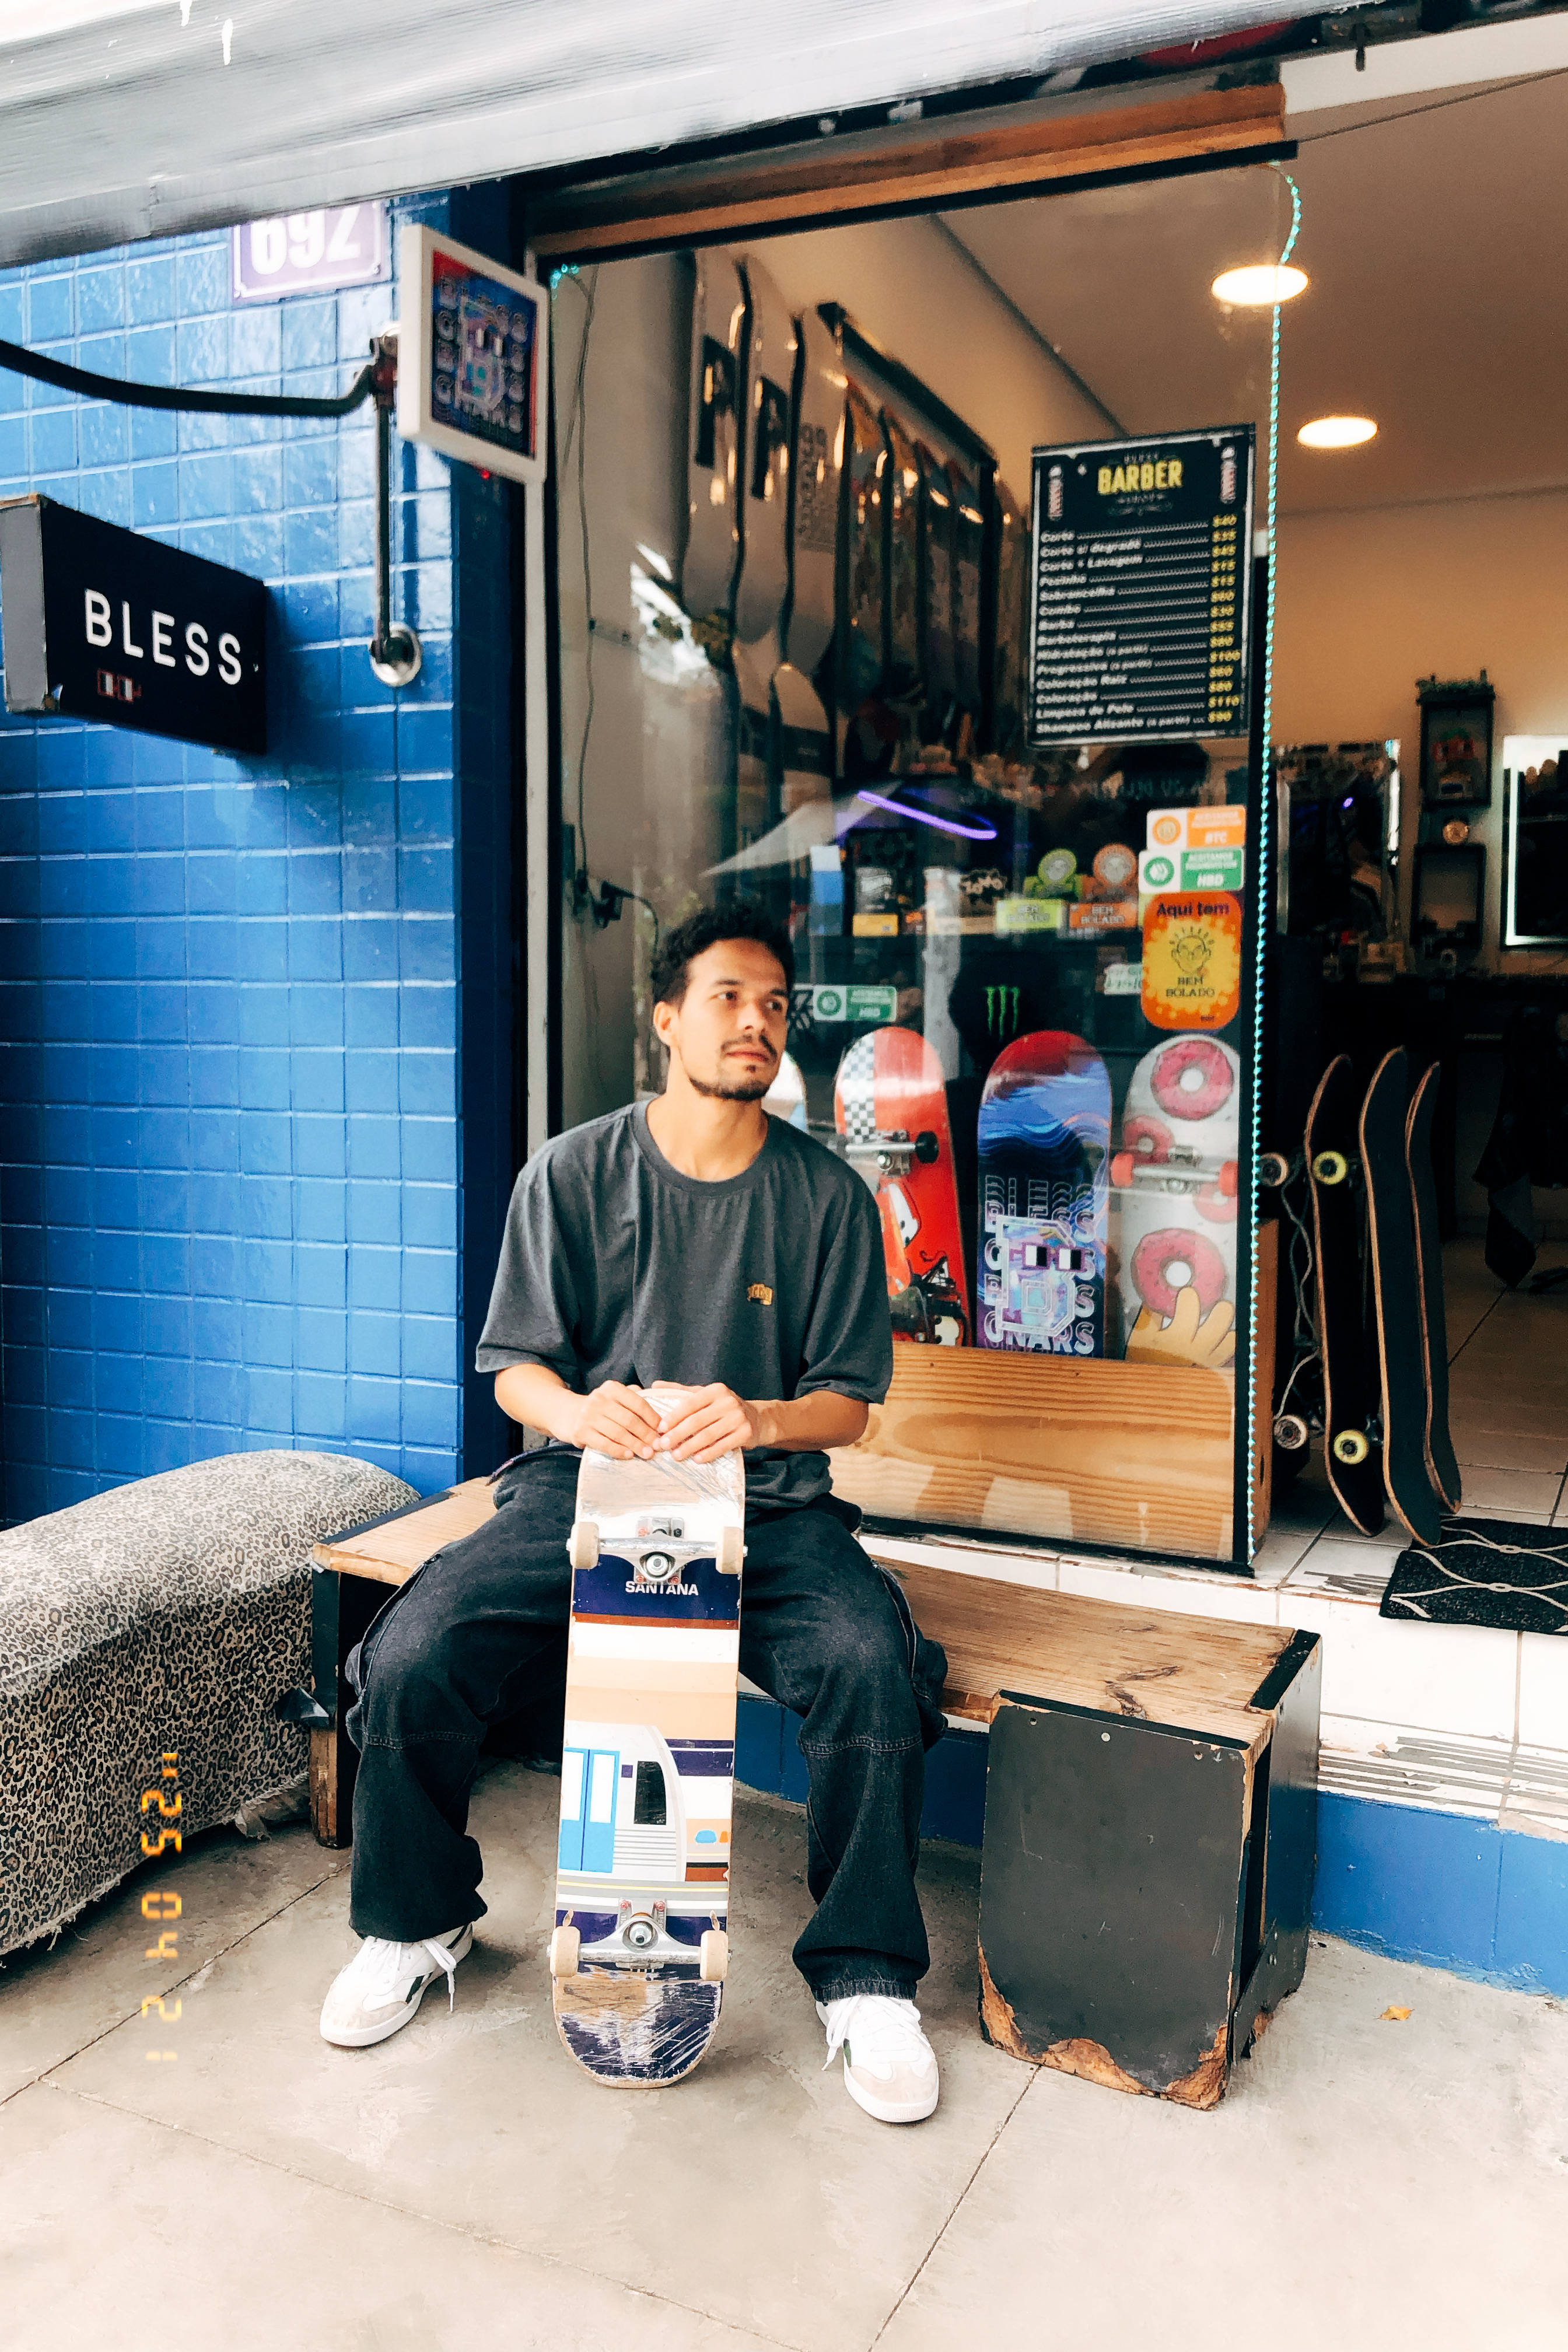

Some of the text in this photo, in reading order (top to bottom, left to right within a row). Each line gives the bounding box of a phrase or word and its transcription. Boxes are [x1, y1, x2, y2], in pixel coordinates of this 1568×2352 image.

[1098, 460, 1184, 495] BARBER
[85, 588, 242, 685] BLESS
[1157, 901, 1230, 919] Aqui tem
[1178, 977, 1203, 985] BEM
[1166, 988, 1215, 998] BOLADO
[625, 1580, 699, 1596] SANTANA
